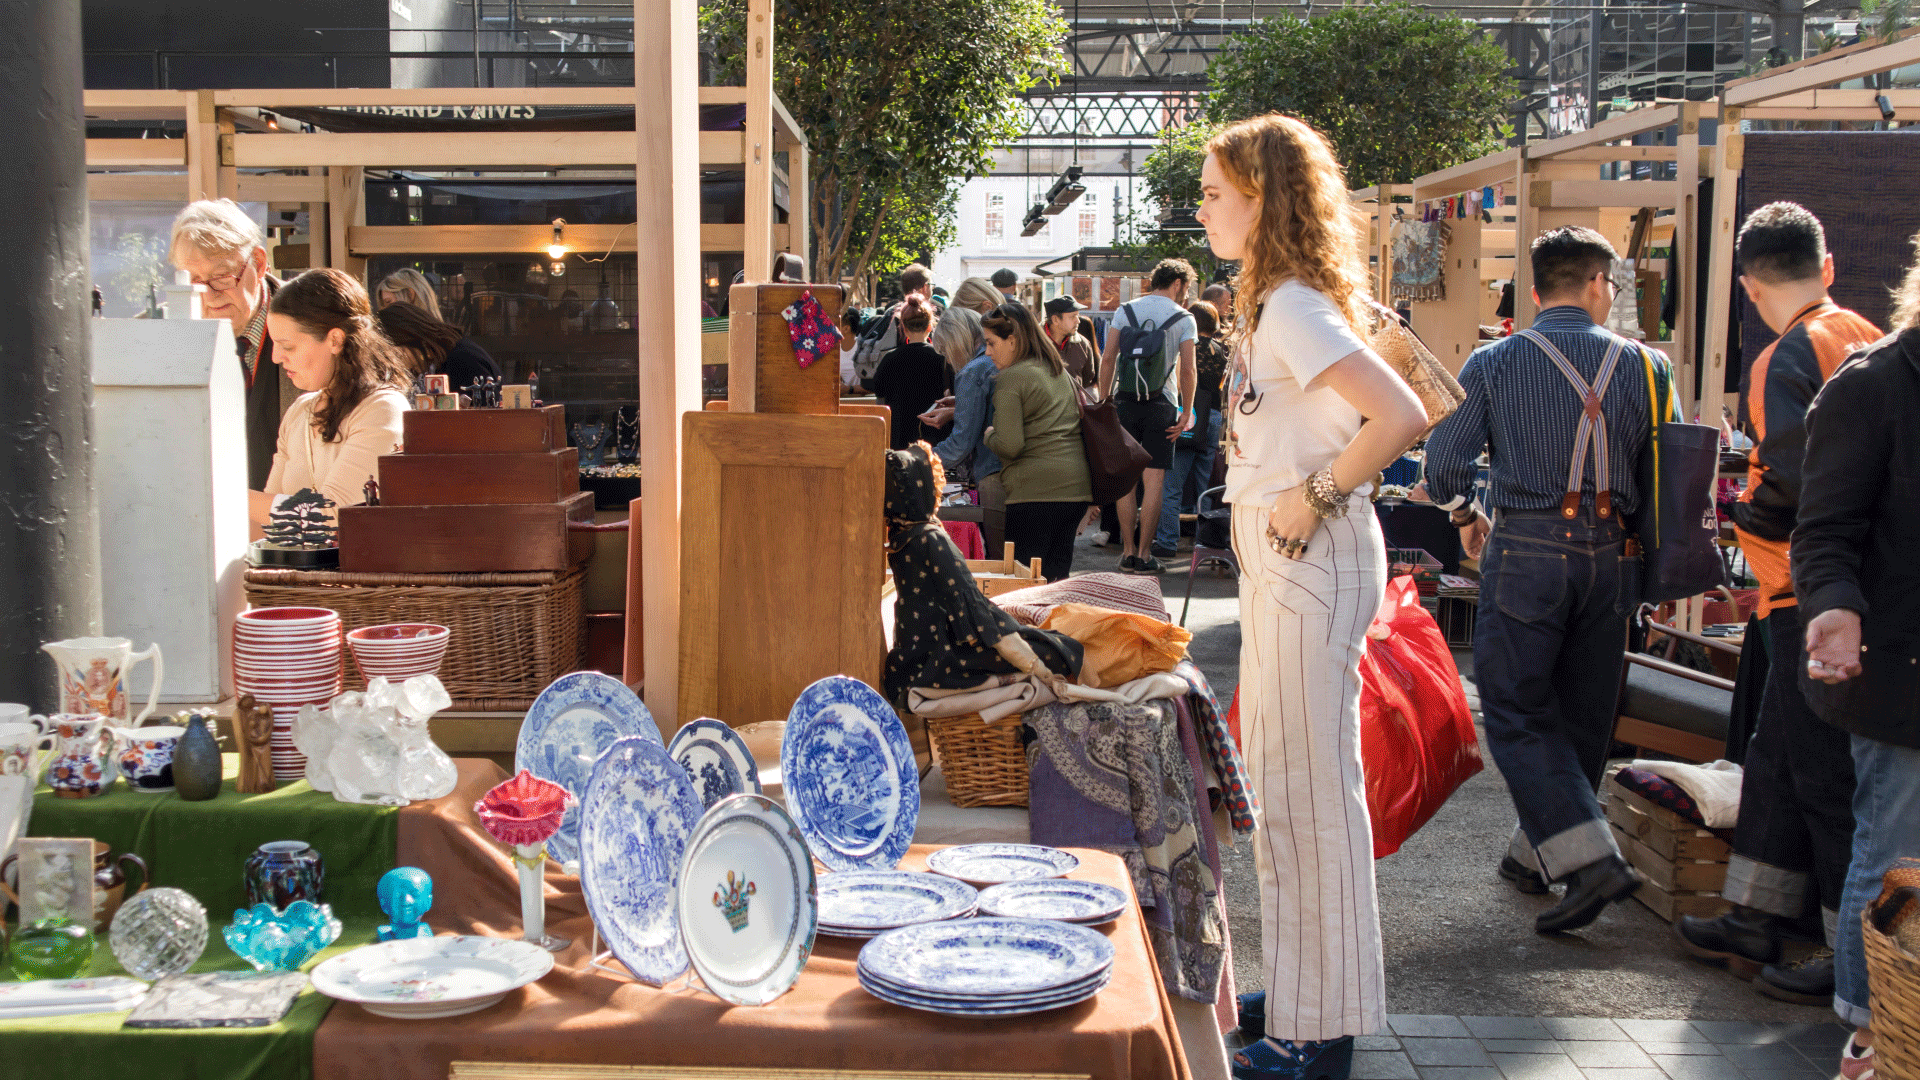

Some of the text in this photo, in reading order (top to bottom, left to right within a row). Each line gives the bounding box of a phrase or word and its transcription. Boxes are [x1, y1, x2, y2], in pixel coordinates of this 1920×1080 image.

[319, 105, 535, 119] SAND KNIVES
[983, 580, 990, 595] E
